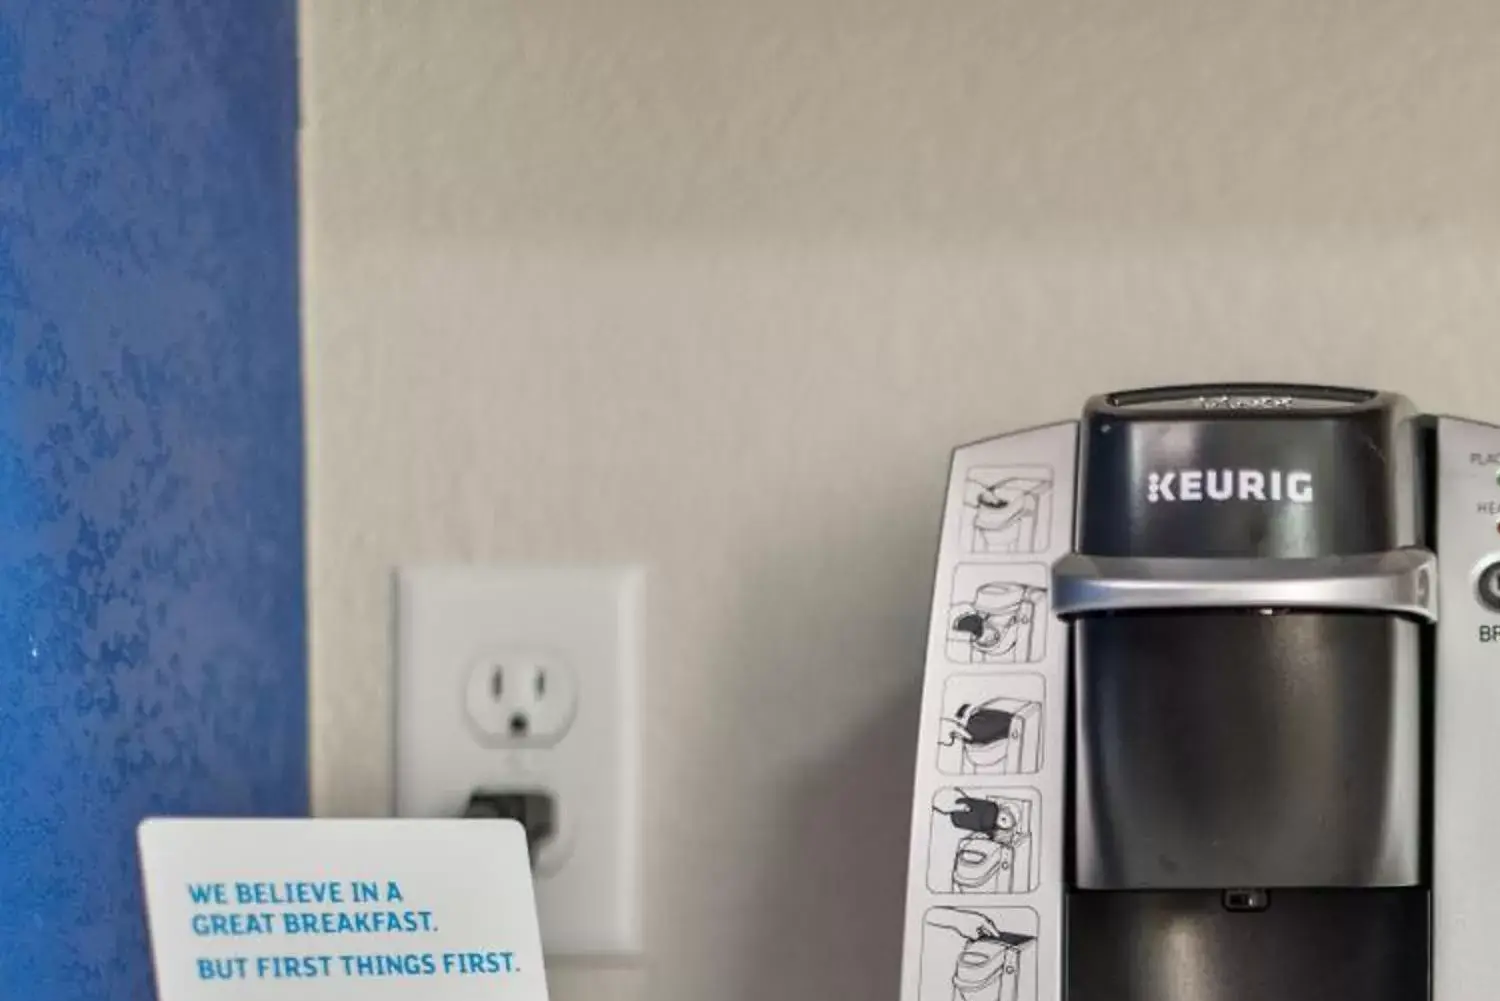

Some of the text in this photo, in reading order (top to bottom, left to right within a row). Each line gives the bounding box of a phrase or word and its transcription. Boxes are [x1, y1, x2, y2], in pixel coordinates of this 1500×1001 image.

[1148, 469, 1313, 503] KEURIG
[188, 881, 404, 905] WE BELIEVE IN A
[191, 911, 439, 936] GREAT BREAKFAST.
[196, 951, 521, 980] BUT FIRST THINGS FIRST.
